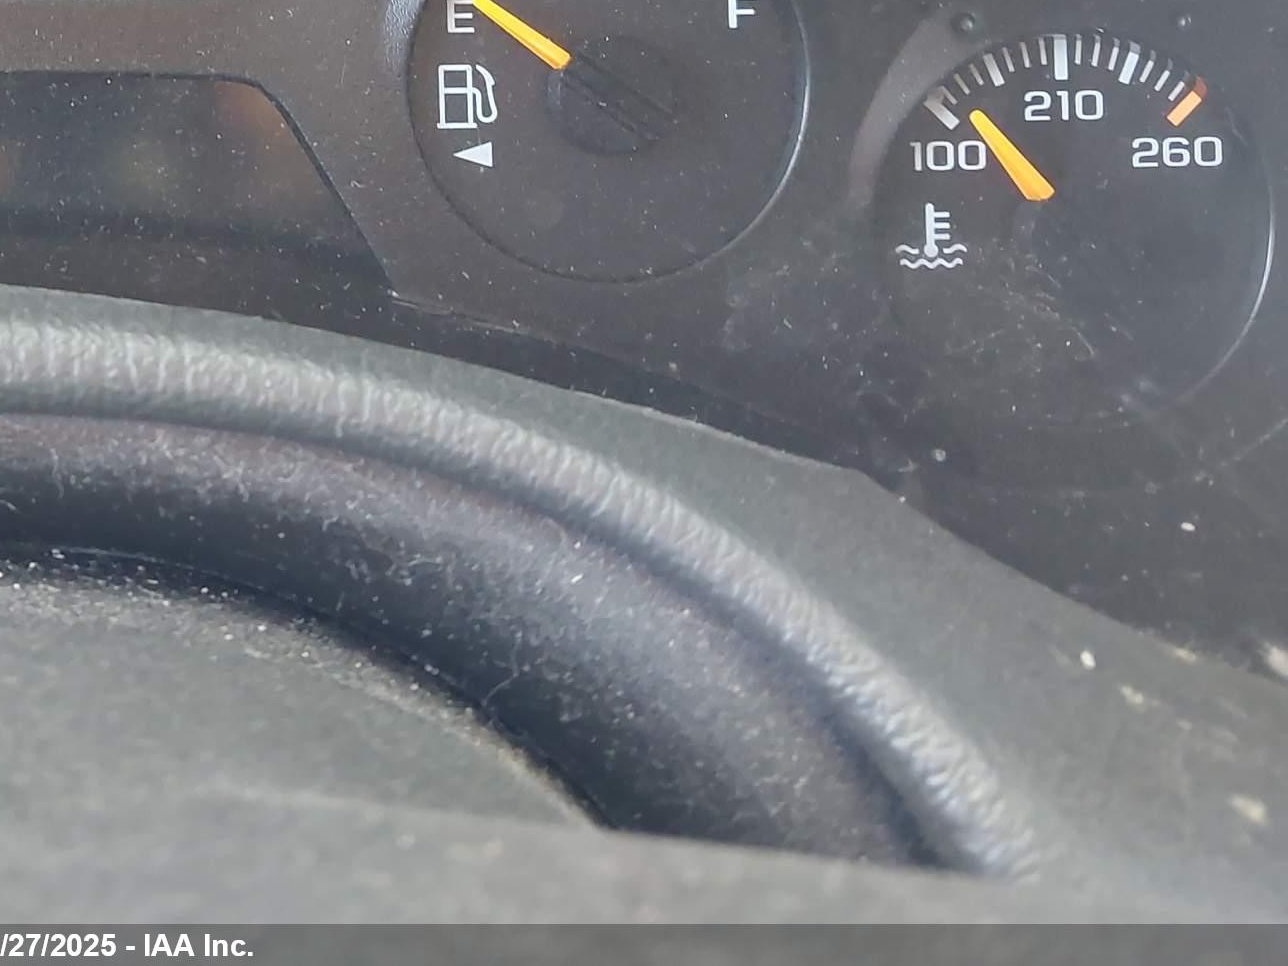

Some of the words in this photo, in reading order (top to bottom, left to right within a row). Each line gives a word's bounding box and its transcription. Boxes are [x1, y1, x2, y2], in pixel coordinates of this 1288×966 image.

[447, 1, 476, 33] E
[1025, 90, 1103, 120] 210
[911, 141, 987, 170] 100
[1132, 137, 1222, 167] 260
